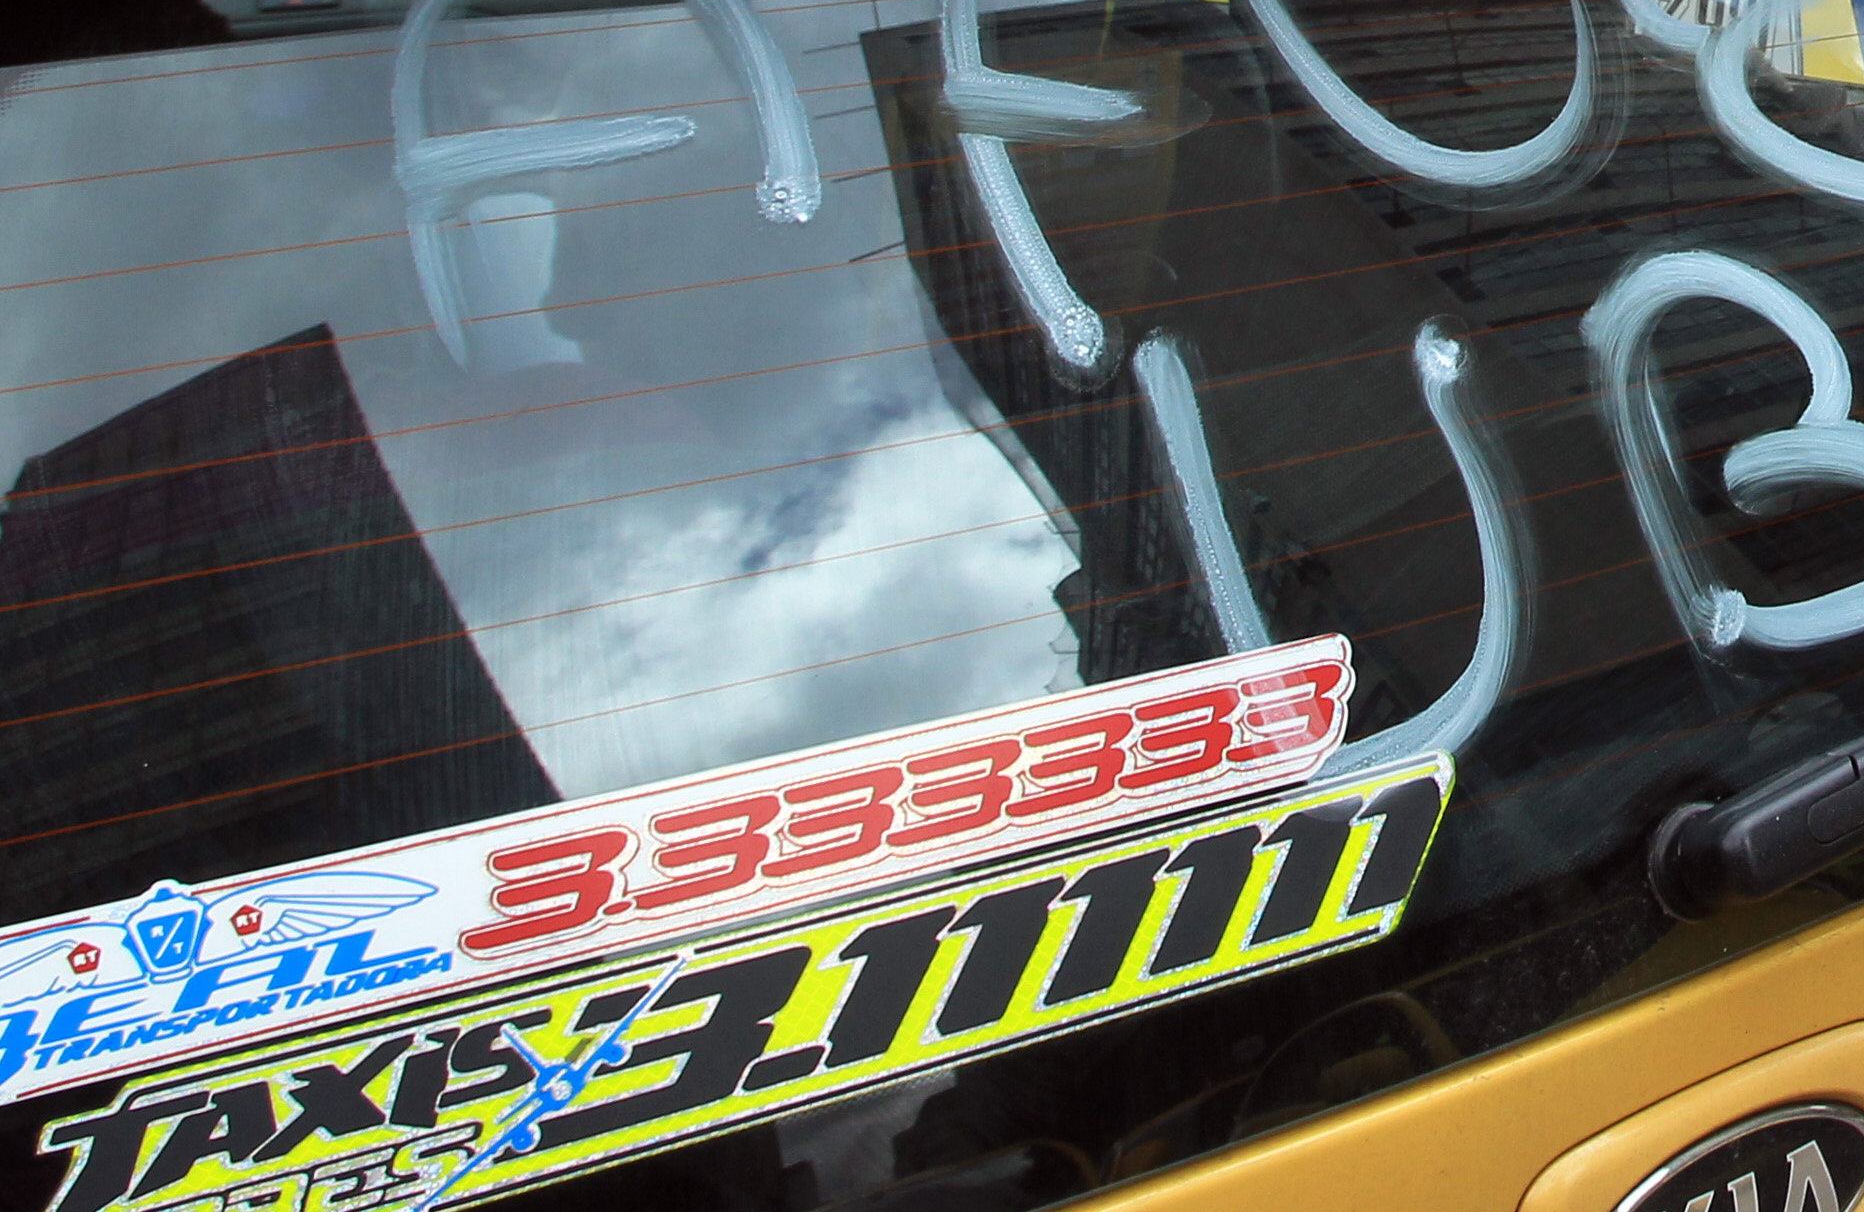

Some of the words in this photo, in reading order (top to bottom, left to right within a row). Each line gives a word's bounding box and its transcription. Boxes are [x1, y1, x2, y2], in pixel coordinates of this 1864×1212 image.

[463, 663, 1341, 950] 3.333333
[32, 951, 453, 1070] TRANSPORTADORA
[47, 1007, 553, 1212] TAXIS
[495, 777, 1443, 1164] 3.111111
